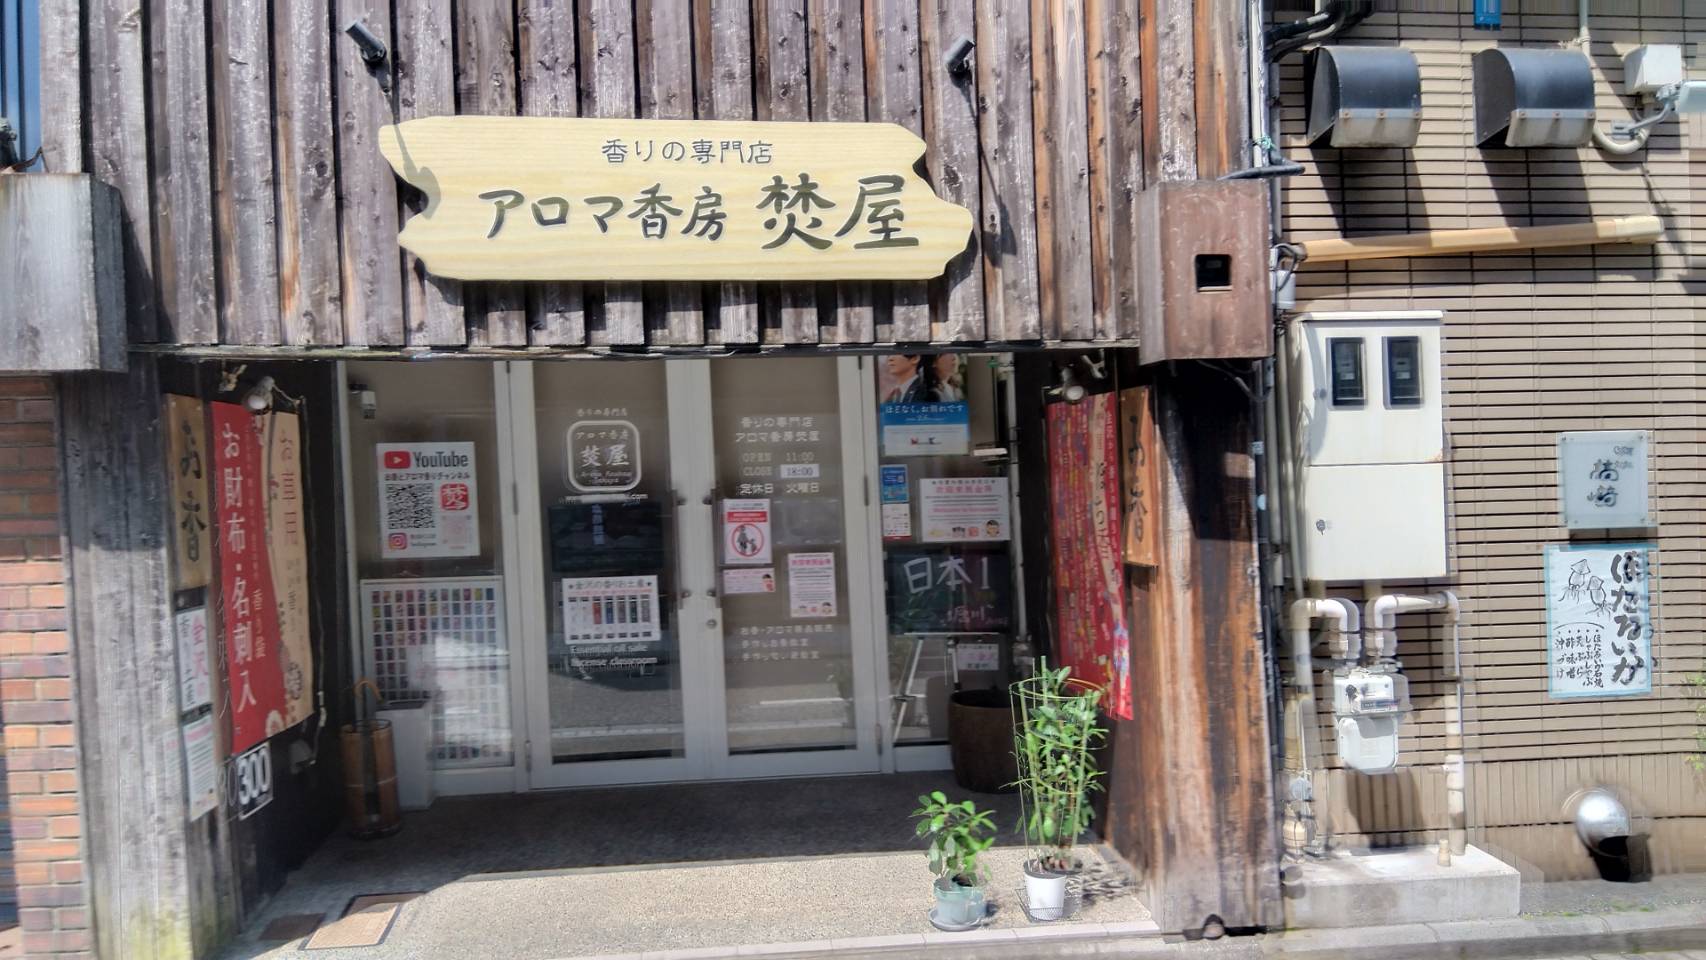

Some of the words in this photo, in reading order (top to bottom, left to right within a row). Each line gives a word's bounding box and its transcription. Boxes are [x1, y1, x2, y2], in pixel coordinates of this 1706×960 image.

[601, 137, 776, 165] 香りの専門店
[477, 182, 728, 242] アロマ香房
[754, 172, 921, 251] 焚屋
[741, 416, 814, 428] 香りの専門店
[735, 431, 820, 442] アロマ香房焚屋
[413, 450, 469, 468] YouTube
[580, 444, 630, 468] 焚屋
[739, 483, 774, 495] 定休日
[786, 482, 820, 493] 火曜日
[222, 422, 257, 713] お財布・名刺入
[1611, 550, 1645, 686] ほたるいか
